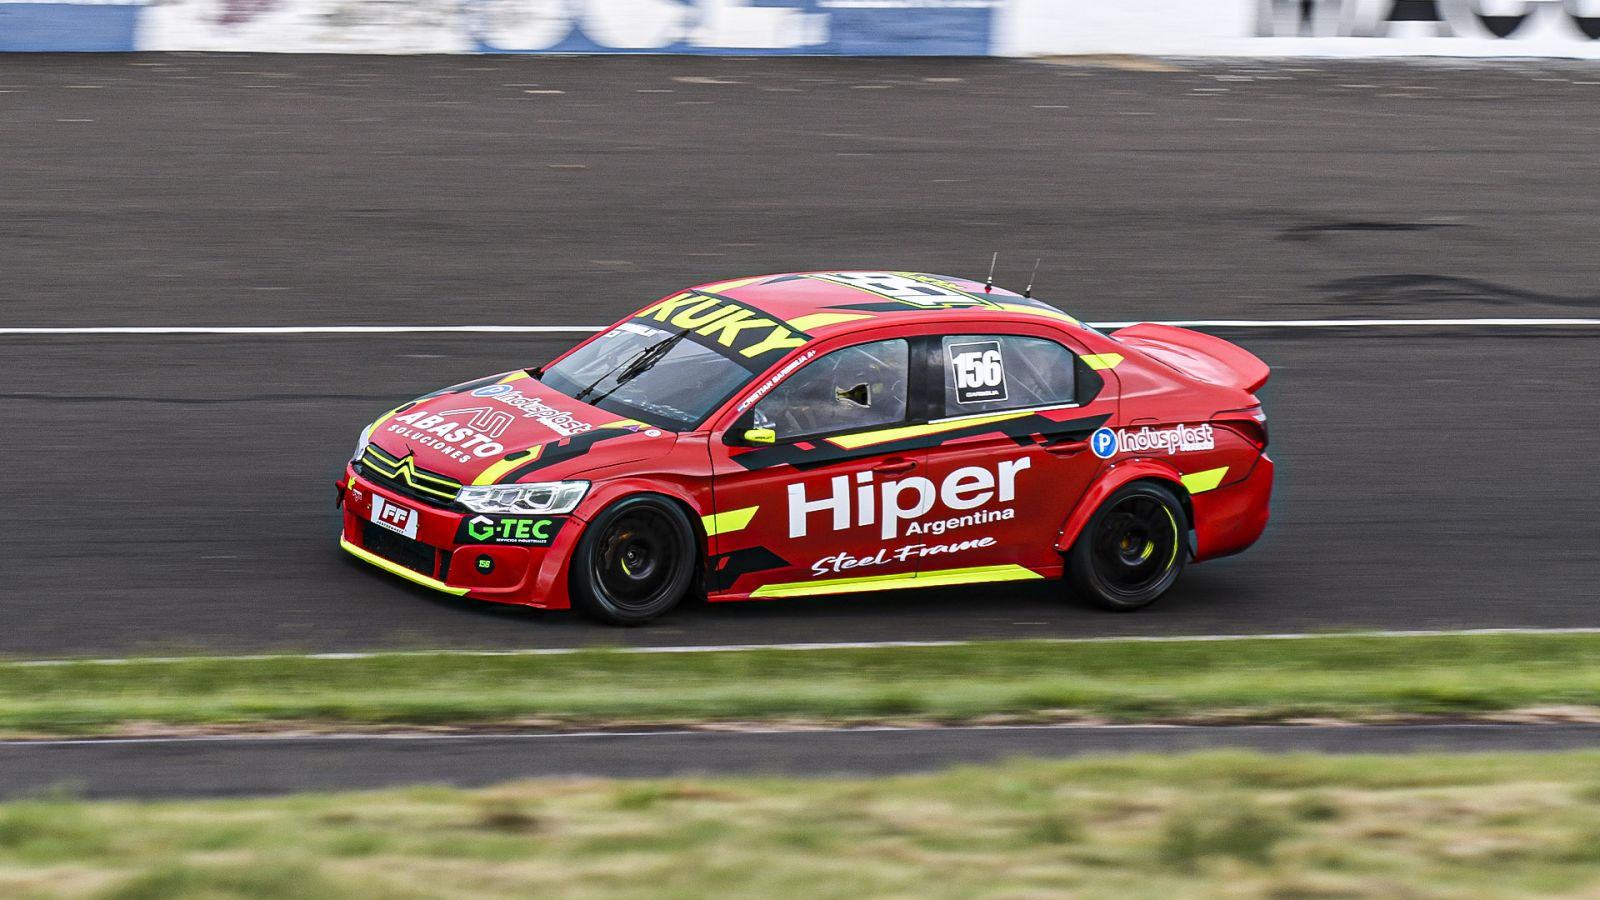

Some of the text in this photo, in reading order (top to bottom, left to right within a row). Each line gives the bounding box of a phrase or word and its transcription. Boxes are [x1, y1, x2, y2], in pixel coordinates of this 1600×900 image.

[636, 292, 808, 358] KUKY
[952, 350, 1002, 388] 156
[387, 424, 471, 464] SOLUCIONES
[396, 411, 503, 458] ABASTO
[1119, 425, 1214, 454] Indusplast
[382, 503, 408, 524] FF
[787, 456, 1031, 540] Hiper
[468, 515, 553, 541] G-TEC
[905, 508, 1015, 537] Argentina
[811, 536, 997, 576] Steel Frame
